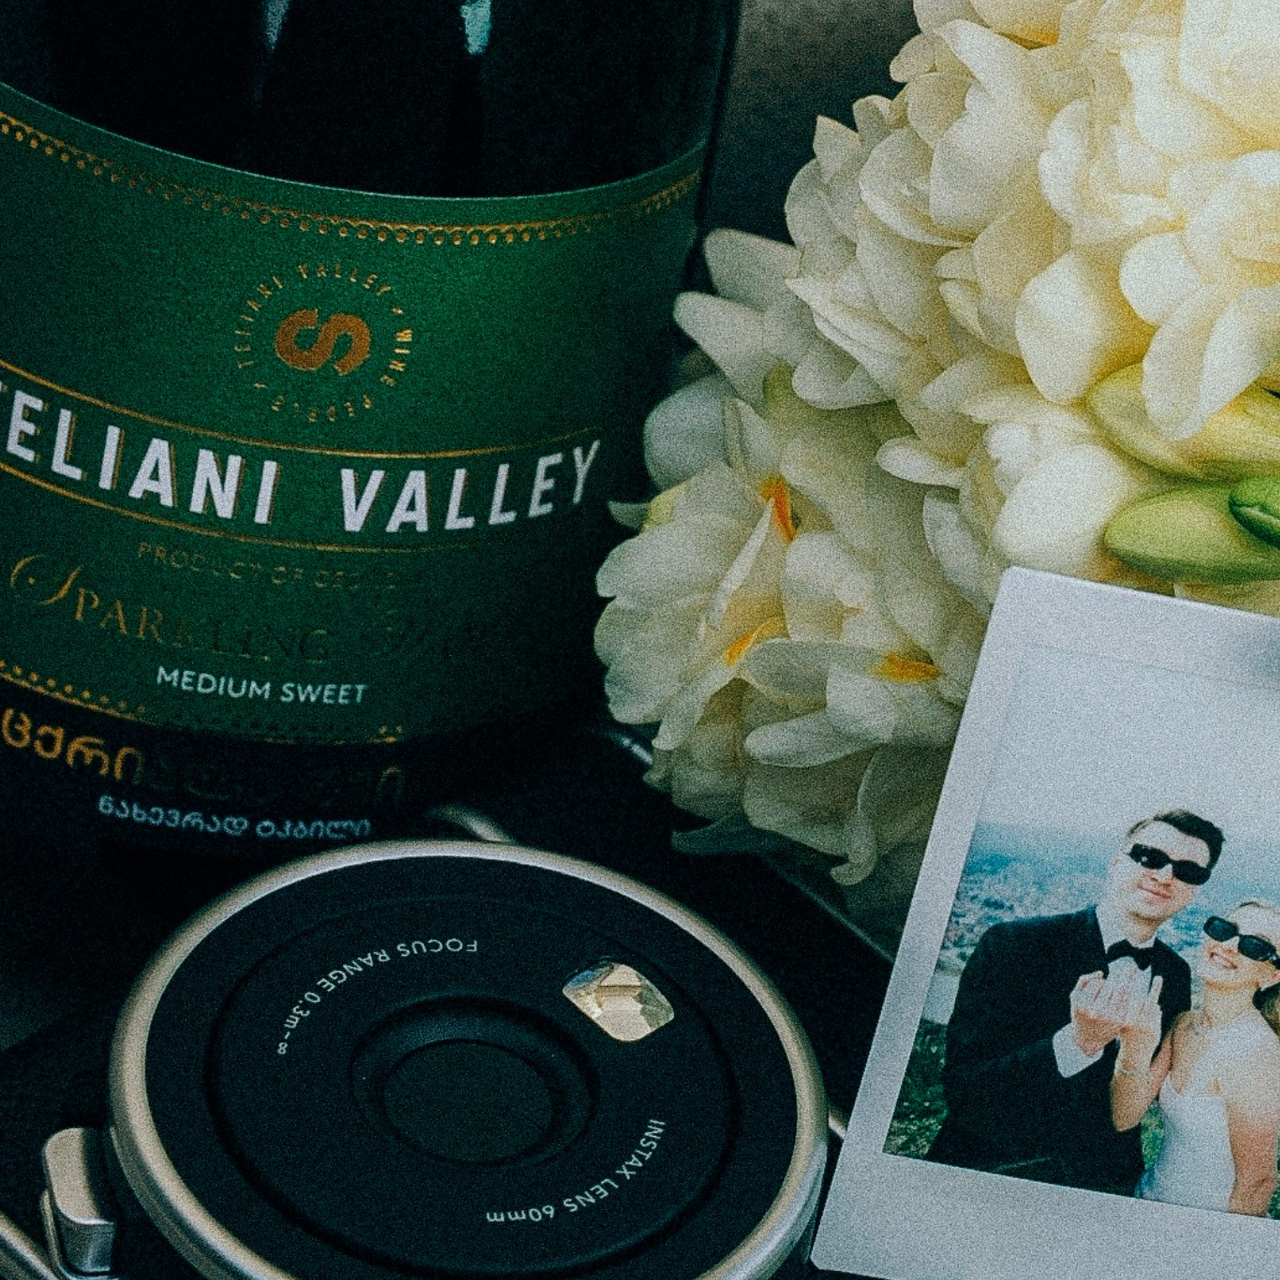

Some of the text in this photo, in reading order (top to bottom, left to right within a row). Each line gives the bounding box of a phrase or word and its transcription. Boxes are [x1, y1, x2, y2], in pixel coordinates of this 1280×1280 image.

[0, 380, 601, 534] ELIANI VALLEY
[155, 665, 367, 706] MEDIUM SWEET
[396, 937, 479, 958] FOCUS
[316, 948, 391, 993] RANGE
[485, 1118, 667, 1223] INSTAX LENS 60mm
